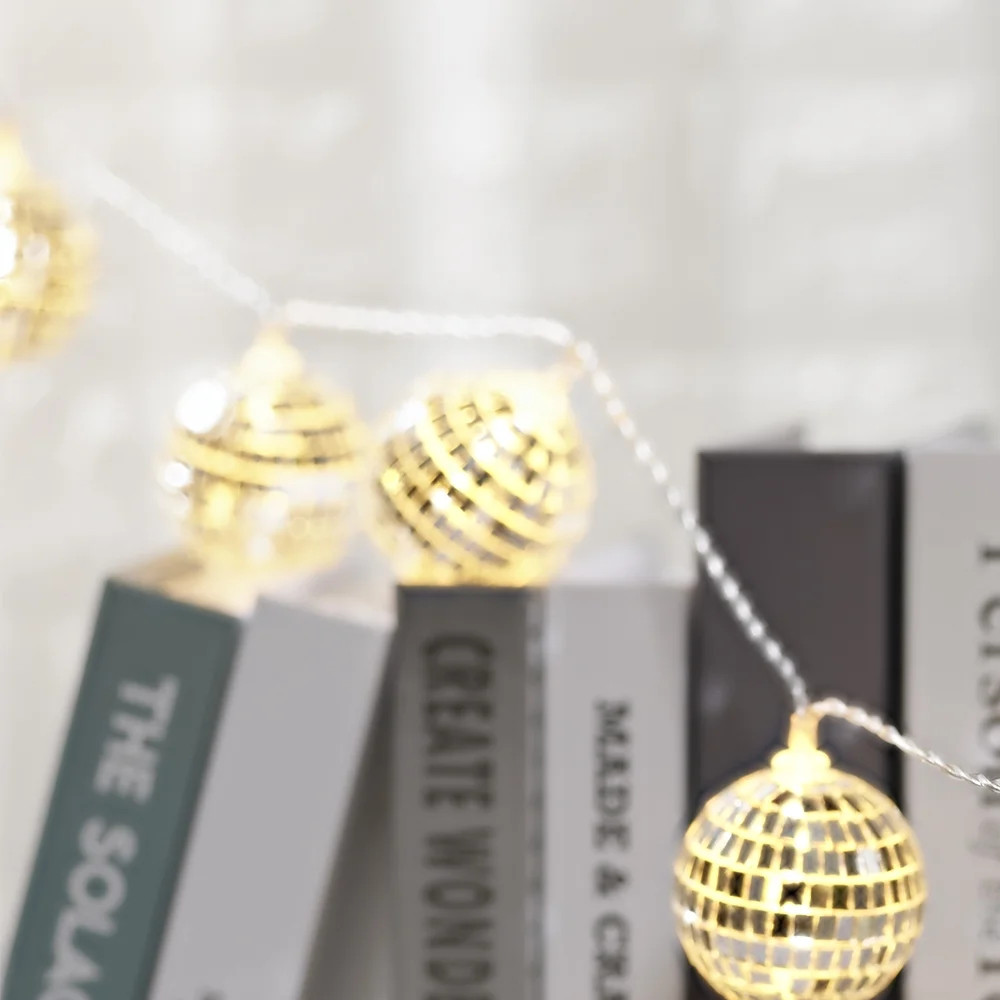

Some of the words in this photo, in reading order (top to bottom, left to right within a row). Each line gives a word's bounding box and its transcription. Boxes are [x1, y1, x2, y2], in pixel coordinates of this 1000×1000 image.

[94, 675, 178, 804] THE
[421, 634, 495, 809] CREATE
[593, 698, 632, 850] MADE
